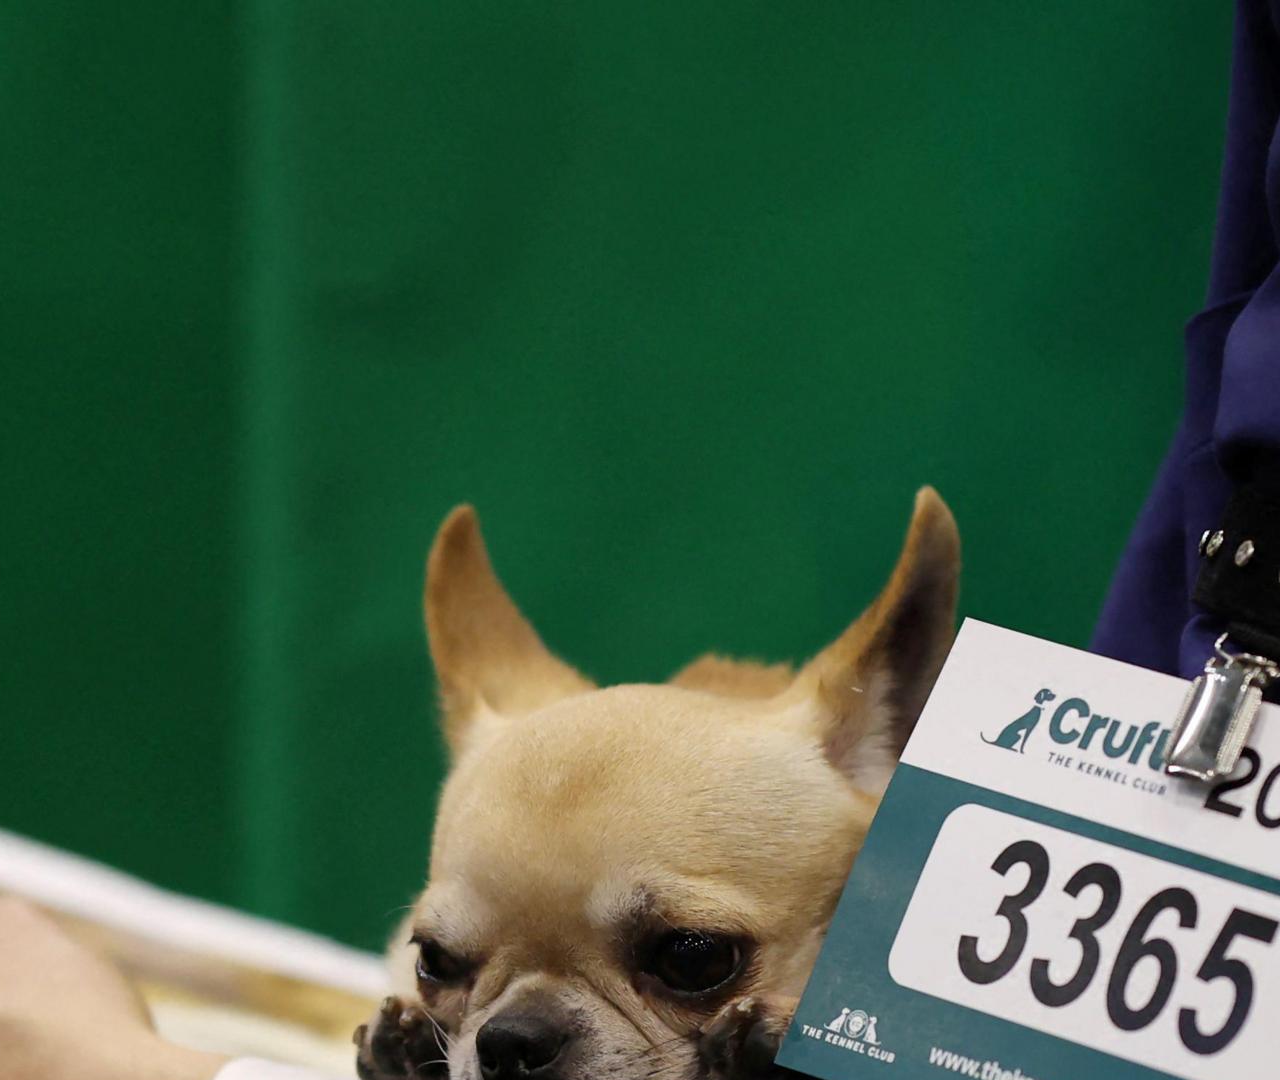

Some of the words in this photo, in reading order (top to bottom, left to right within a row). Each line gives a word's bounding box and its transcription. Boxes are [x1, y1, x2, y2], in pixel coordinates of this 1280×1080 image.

[1048, 697, 1171, 771] Cruft
[1047, 751, 1074, 768] THE
[1076, 761, 1128, 785] KENNEL
[1132, 777, 1168, 796] CLUB
[957, 839, 1280, 1057] 3365
[802, 1024, 824, 1040] THE
[824, 1032, 866, 1055] KENNEL
[867, 1045, 896, 1064] CLUB
